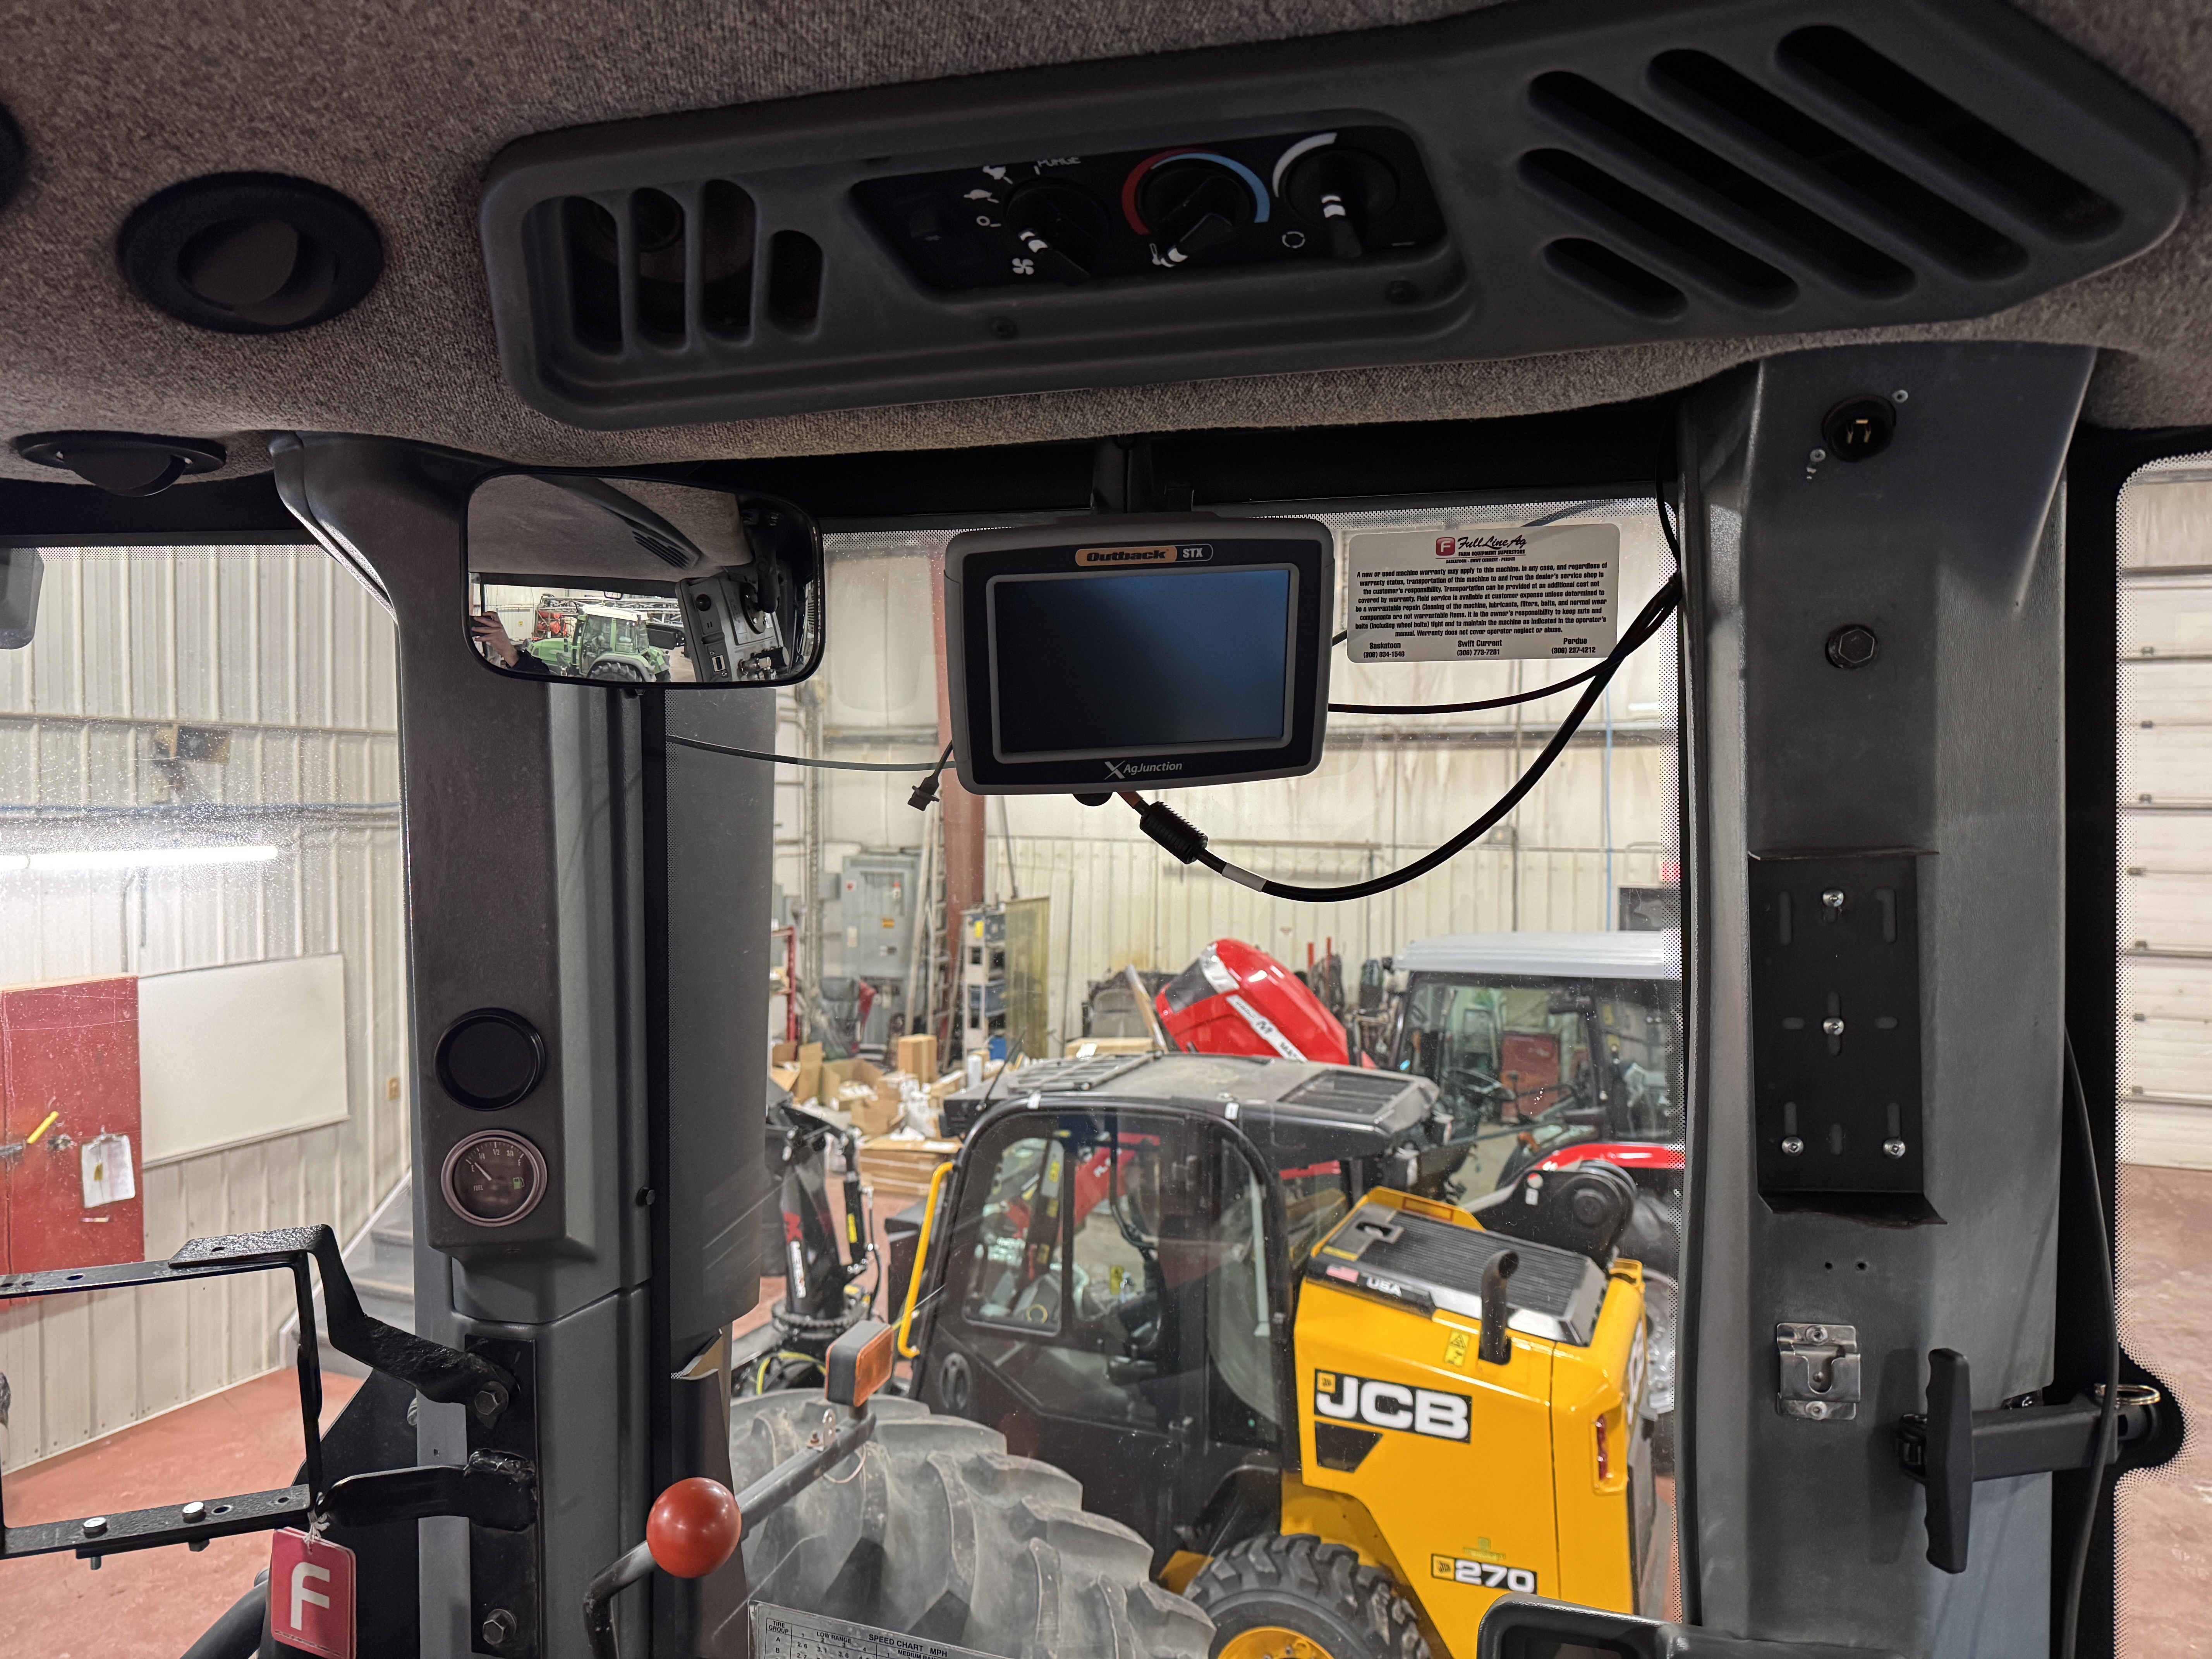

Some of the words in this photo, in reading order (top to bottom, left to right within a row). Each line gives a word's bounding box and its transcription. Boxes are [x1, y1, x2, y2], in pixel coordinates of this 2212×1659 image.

[1441, 541, 1451, 552] F
[1457, 537, 1484, 550] Full
[1482, 536, 1509, 550] Line
[1507, 534, 1527, 549] Ag
[1087, 550, 1166, 561] Outback
[1183, 548, 1203, 558] STX
[1506, 583, 1530, 591] provided
[1123, 762, 1183, 775] AgJunction
[1367, 1276, 1402, 1297] USA
[1317, 1376, 1468, 1439] JCB
[1455, 1559, 1534, 1593] 270
[290, 1562, 330, 1631] F
[769, 1625, 788, 1633] GROUP
[831, 1635, 852, 1644] RANGE
[869, 1634, 894, 1645] SPEED
[897, 1641, 923, 1652] CHART
[930, 1648, 947, 1657] MPH
[898, 1649, 921, 1659] MEDIUM
